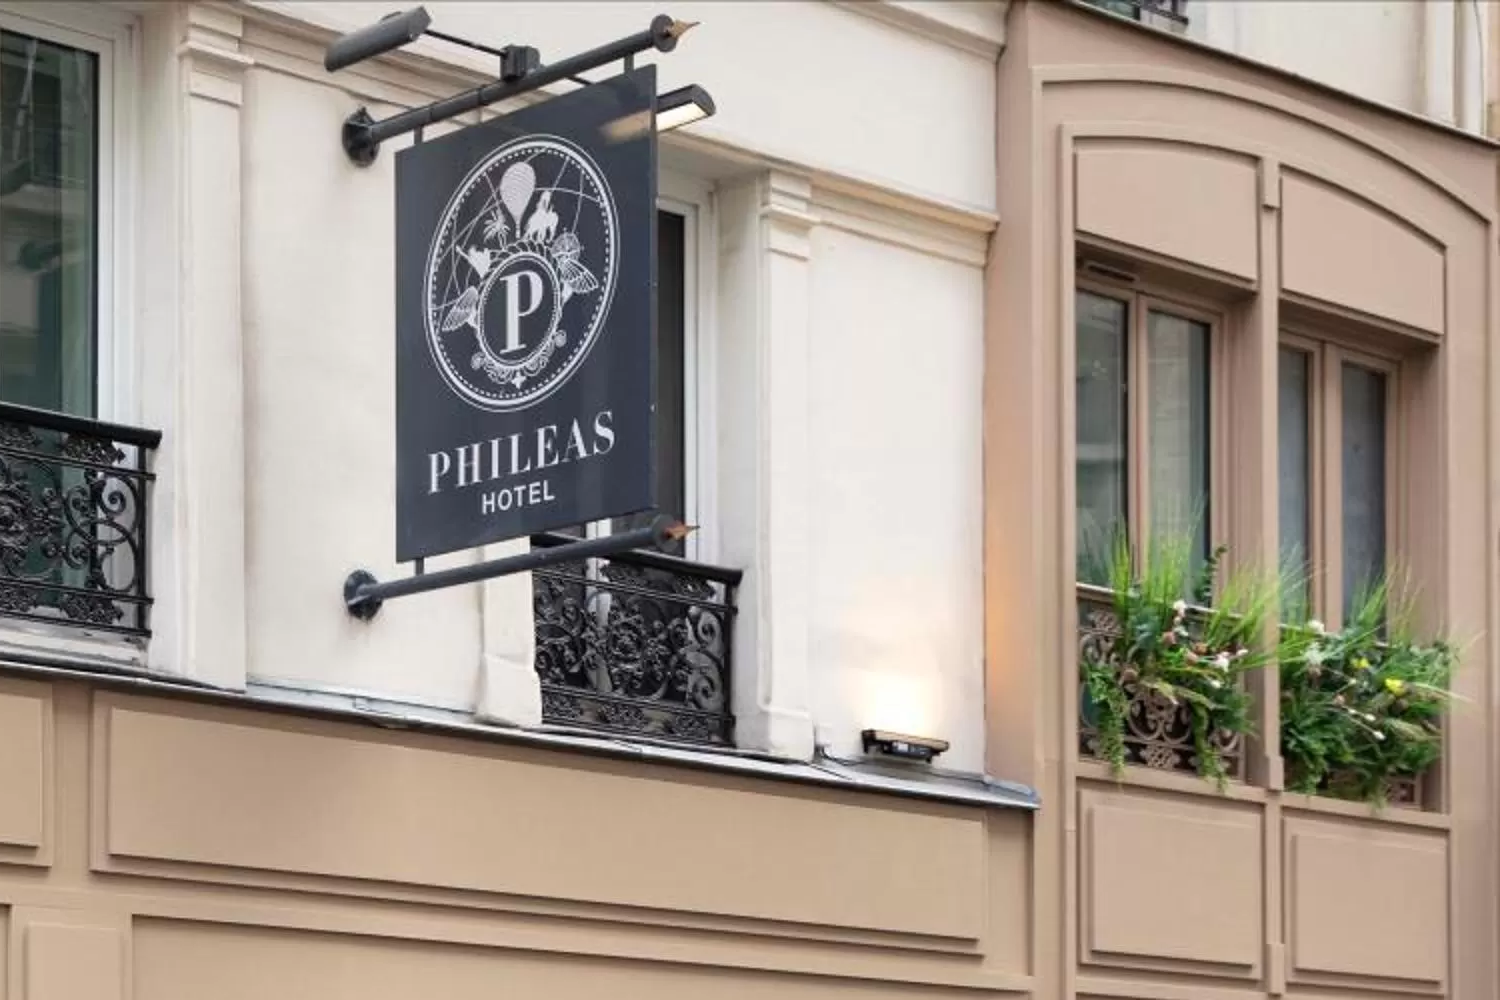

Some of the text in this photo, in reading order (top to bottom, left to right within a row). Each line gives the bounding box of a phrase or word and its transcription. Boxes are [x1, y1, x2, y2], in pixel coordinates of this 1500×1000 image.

[499, 270, 544, 355] P
[428, 410, 616, 495] PHILEAS
[481, 479, 556, 515] HOTEL
